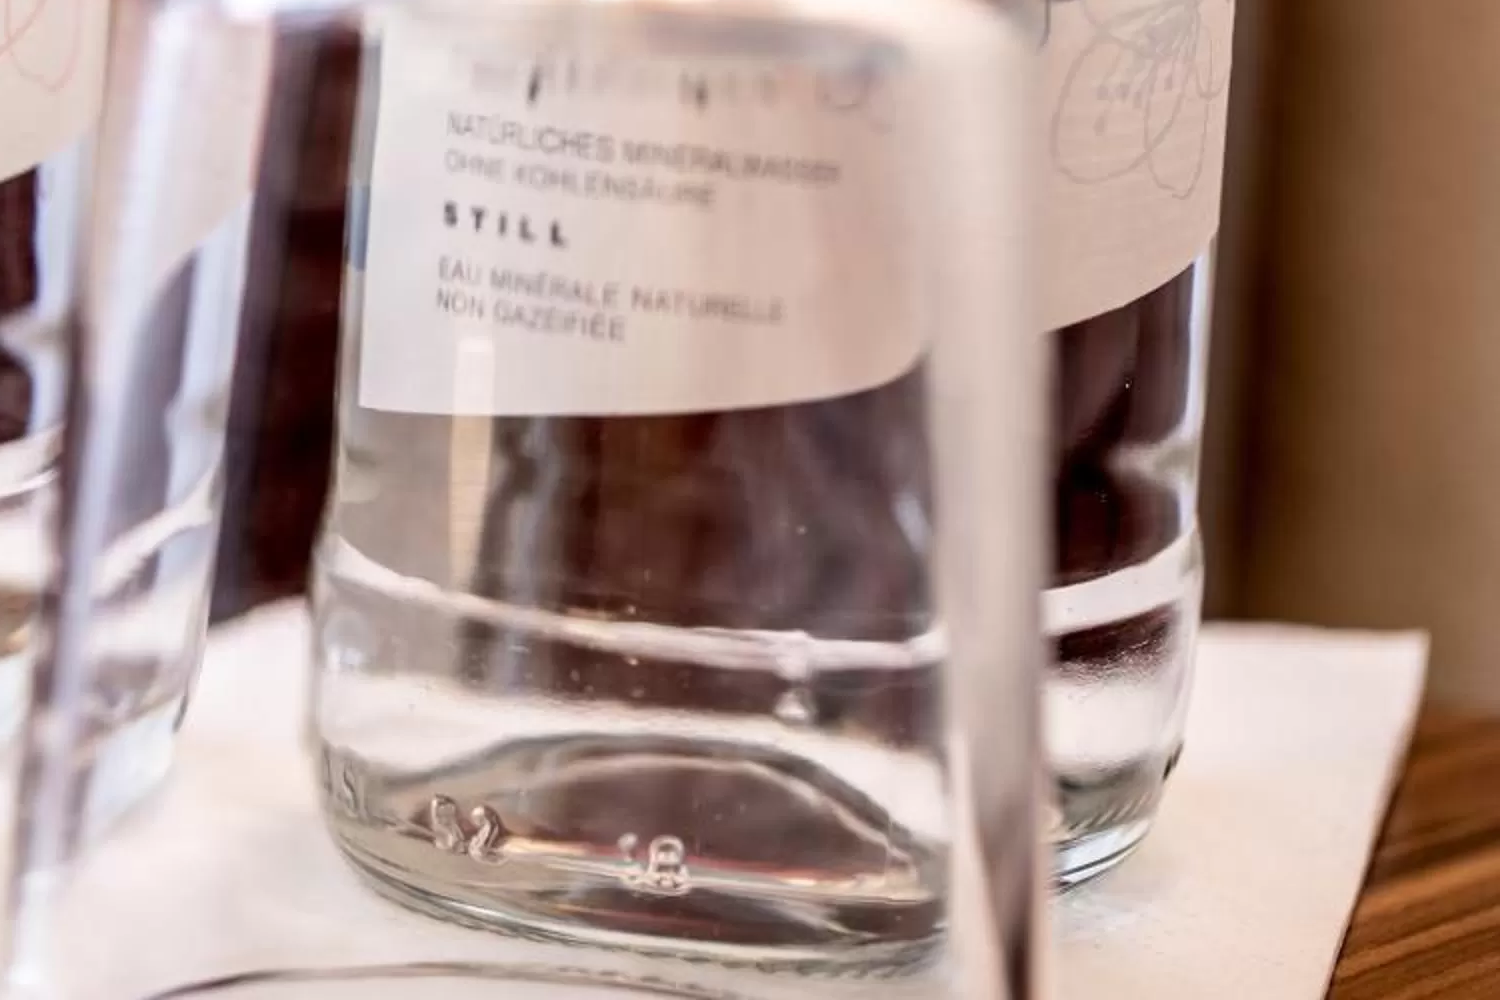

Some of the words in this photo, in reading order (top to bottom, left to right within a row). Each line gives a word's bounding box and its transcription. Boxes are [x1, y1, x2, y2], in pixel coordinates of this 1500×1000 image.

[443, 200, 567, 248] STILL
[437, 255, 481, 286] EAU
[436, 288, 485, 320] NON
